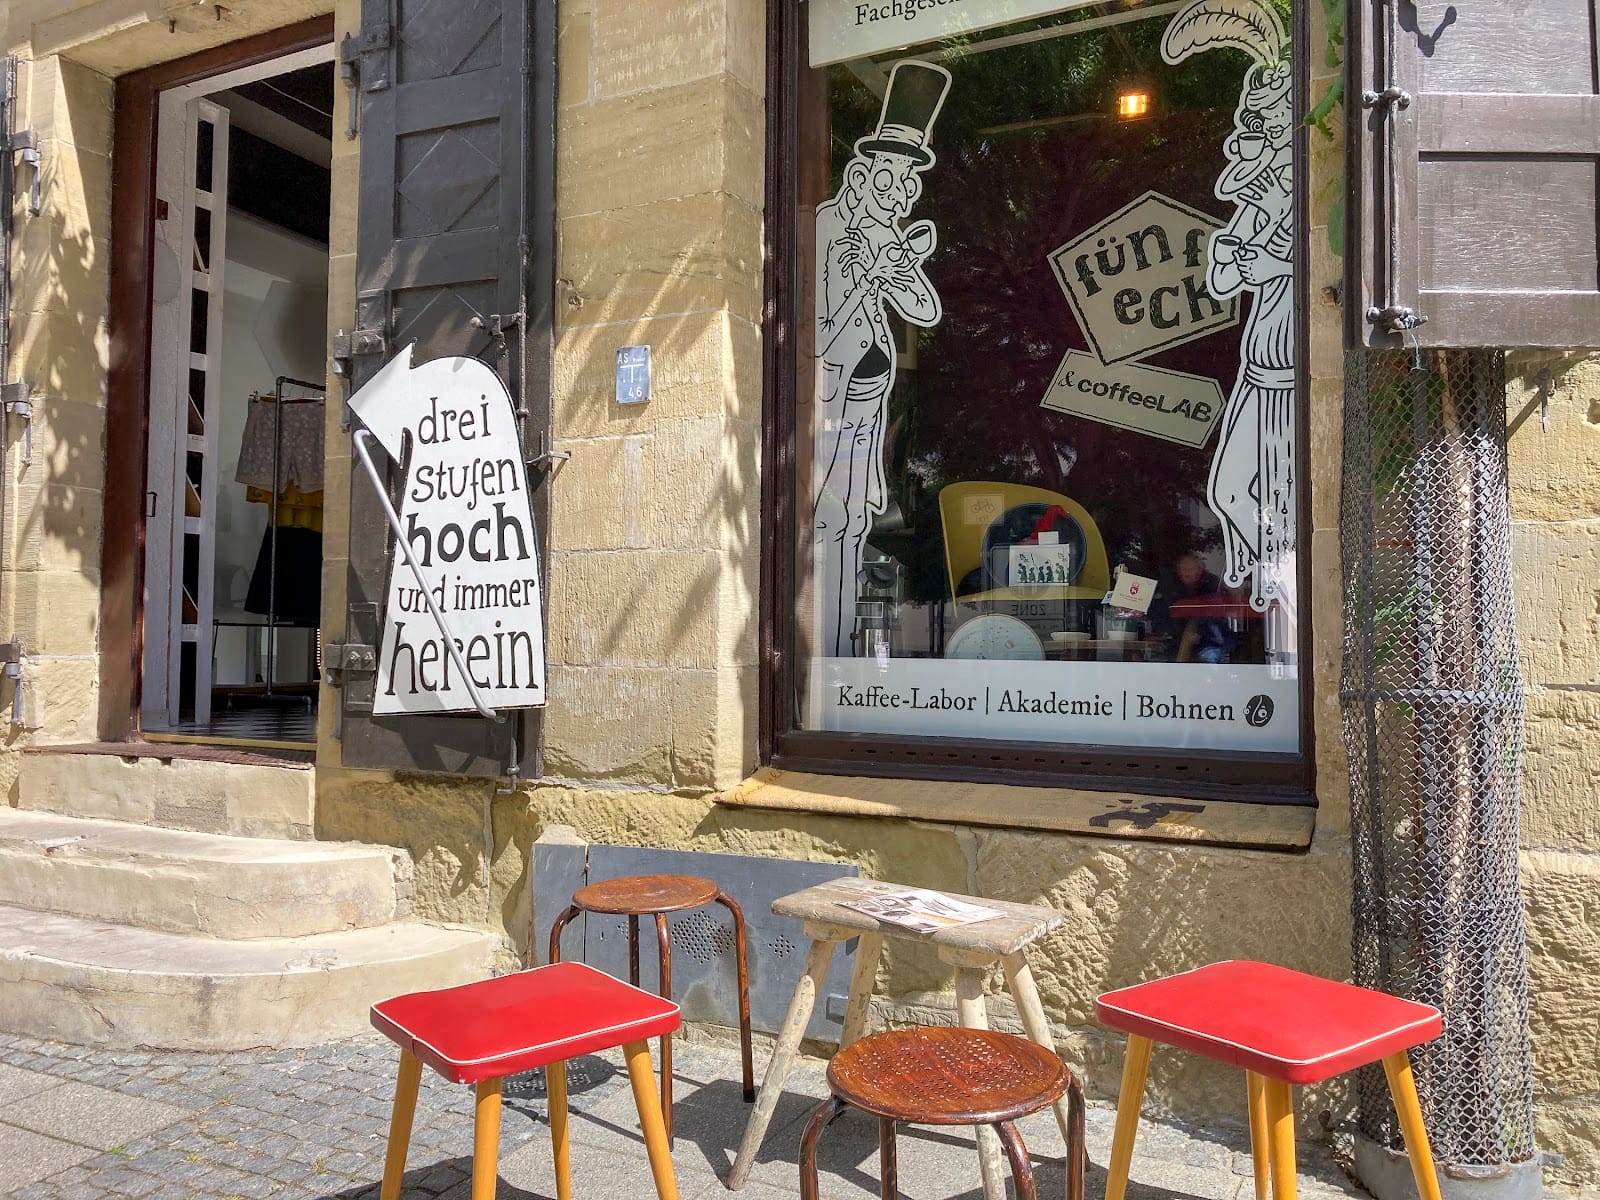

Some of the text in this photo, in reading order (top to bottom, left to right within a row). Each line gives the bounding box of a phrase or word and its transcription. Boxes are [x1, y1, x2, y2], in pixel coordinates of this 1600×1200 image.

[855, 0, 961, 25] Fachges
[1113, 274, 1225, 330] eck
[617, 353, 629, 365] AS
[417, 394, 492, 445] drei
[411, 458, 521, 510] stufen
[401, 502, 531, 567] hoch
[398, 574, 535, 613] und immer
[384, 620, 539, 695] herein
[837, 685, 977, 711] Kaffee-Labor
[998, 689, 1113, 716] Akademie
[1136, 694, 1235, 721] Bohnen
